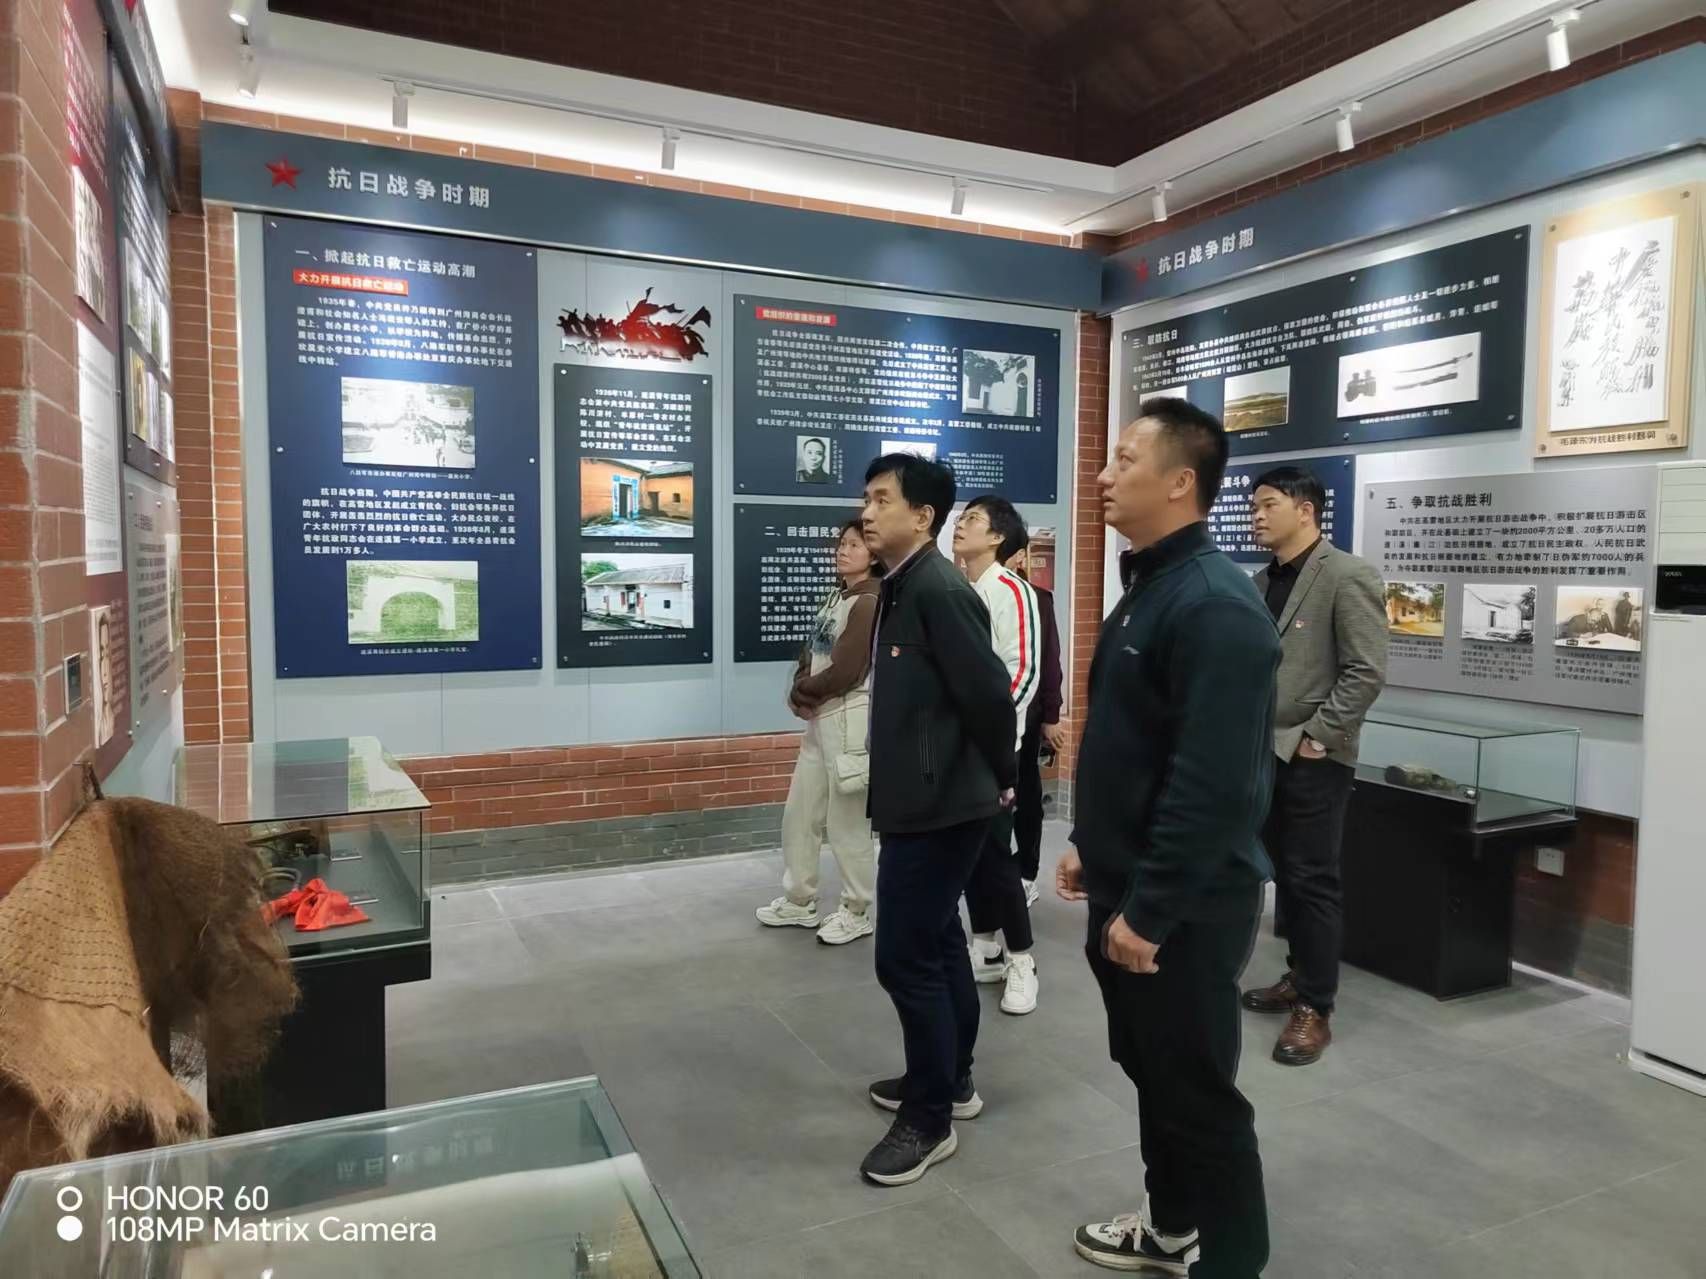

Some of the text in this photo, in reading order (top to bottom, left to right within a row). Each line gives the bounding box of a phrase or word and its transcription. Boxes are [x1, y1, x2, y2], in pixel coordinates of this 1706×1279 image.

[328, 167, 489, 208] 抗日战争时期
[295, 249, 476, 279] 一、掀起抗日救亡运动高潮
[1157, 227, 1255, 275] 抗日战争时期
[1385, 492, 1493, 510] 五、争取抗战胜利
[764, 526, 842, 538] 二、回击国民党
